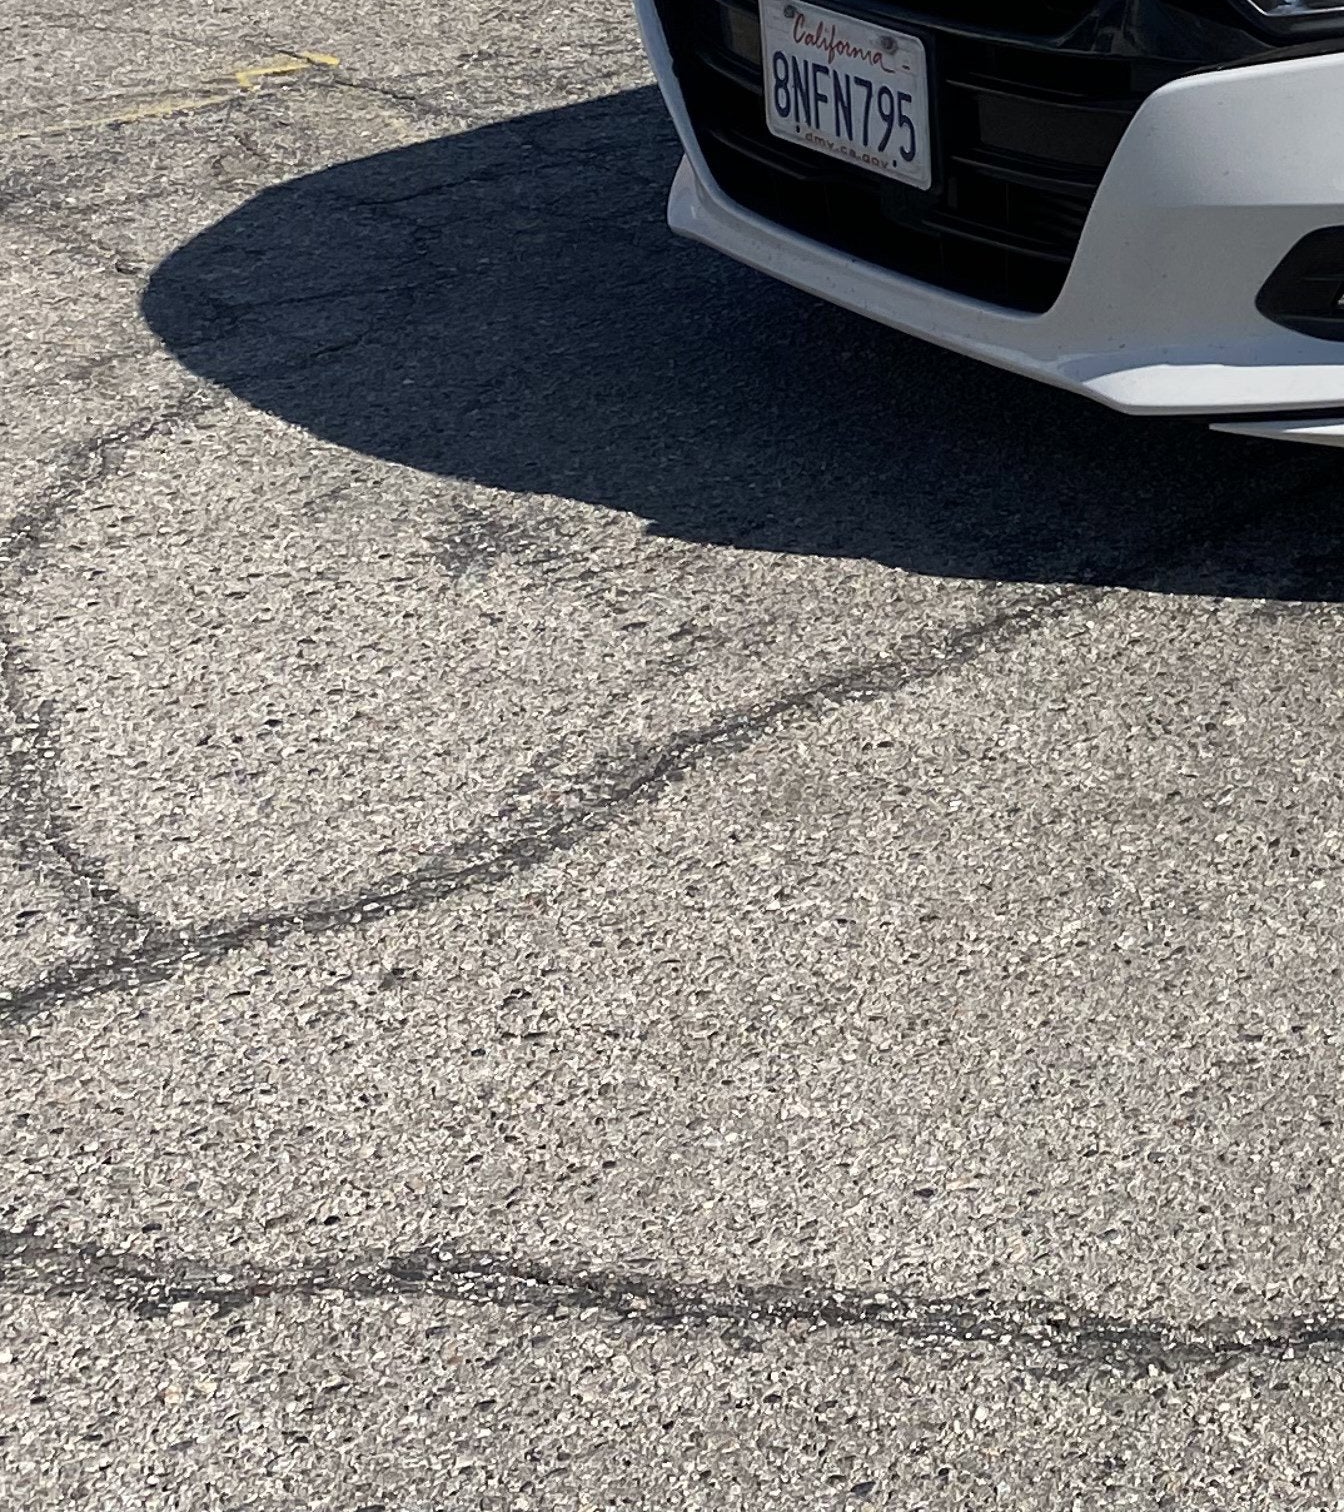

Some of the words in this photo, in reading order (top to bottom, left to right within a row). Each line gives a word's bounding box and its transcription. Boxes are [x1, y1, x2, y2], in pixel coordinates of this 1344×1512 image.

[792, 12, 897, 74] California
[772, 50, 917, 164] 8NFN795
[805, 131, 890, 170] dmv.ca.gov
